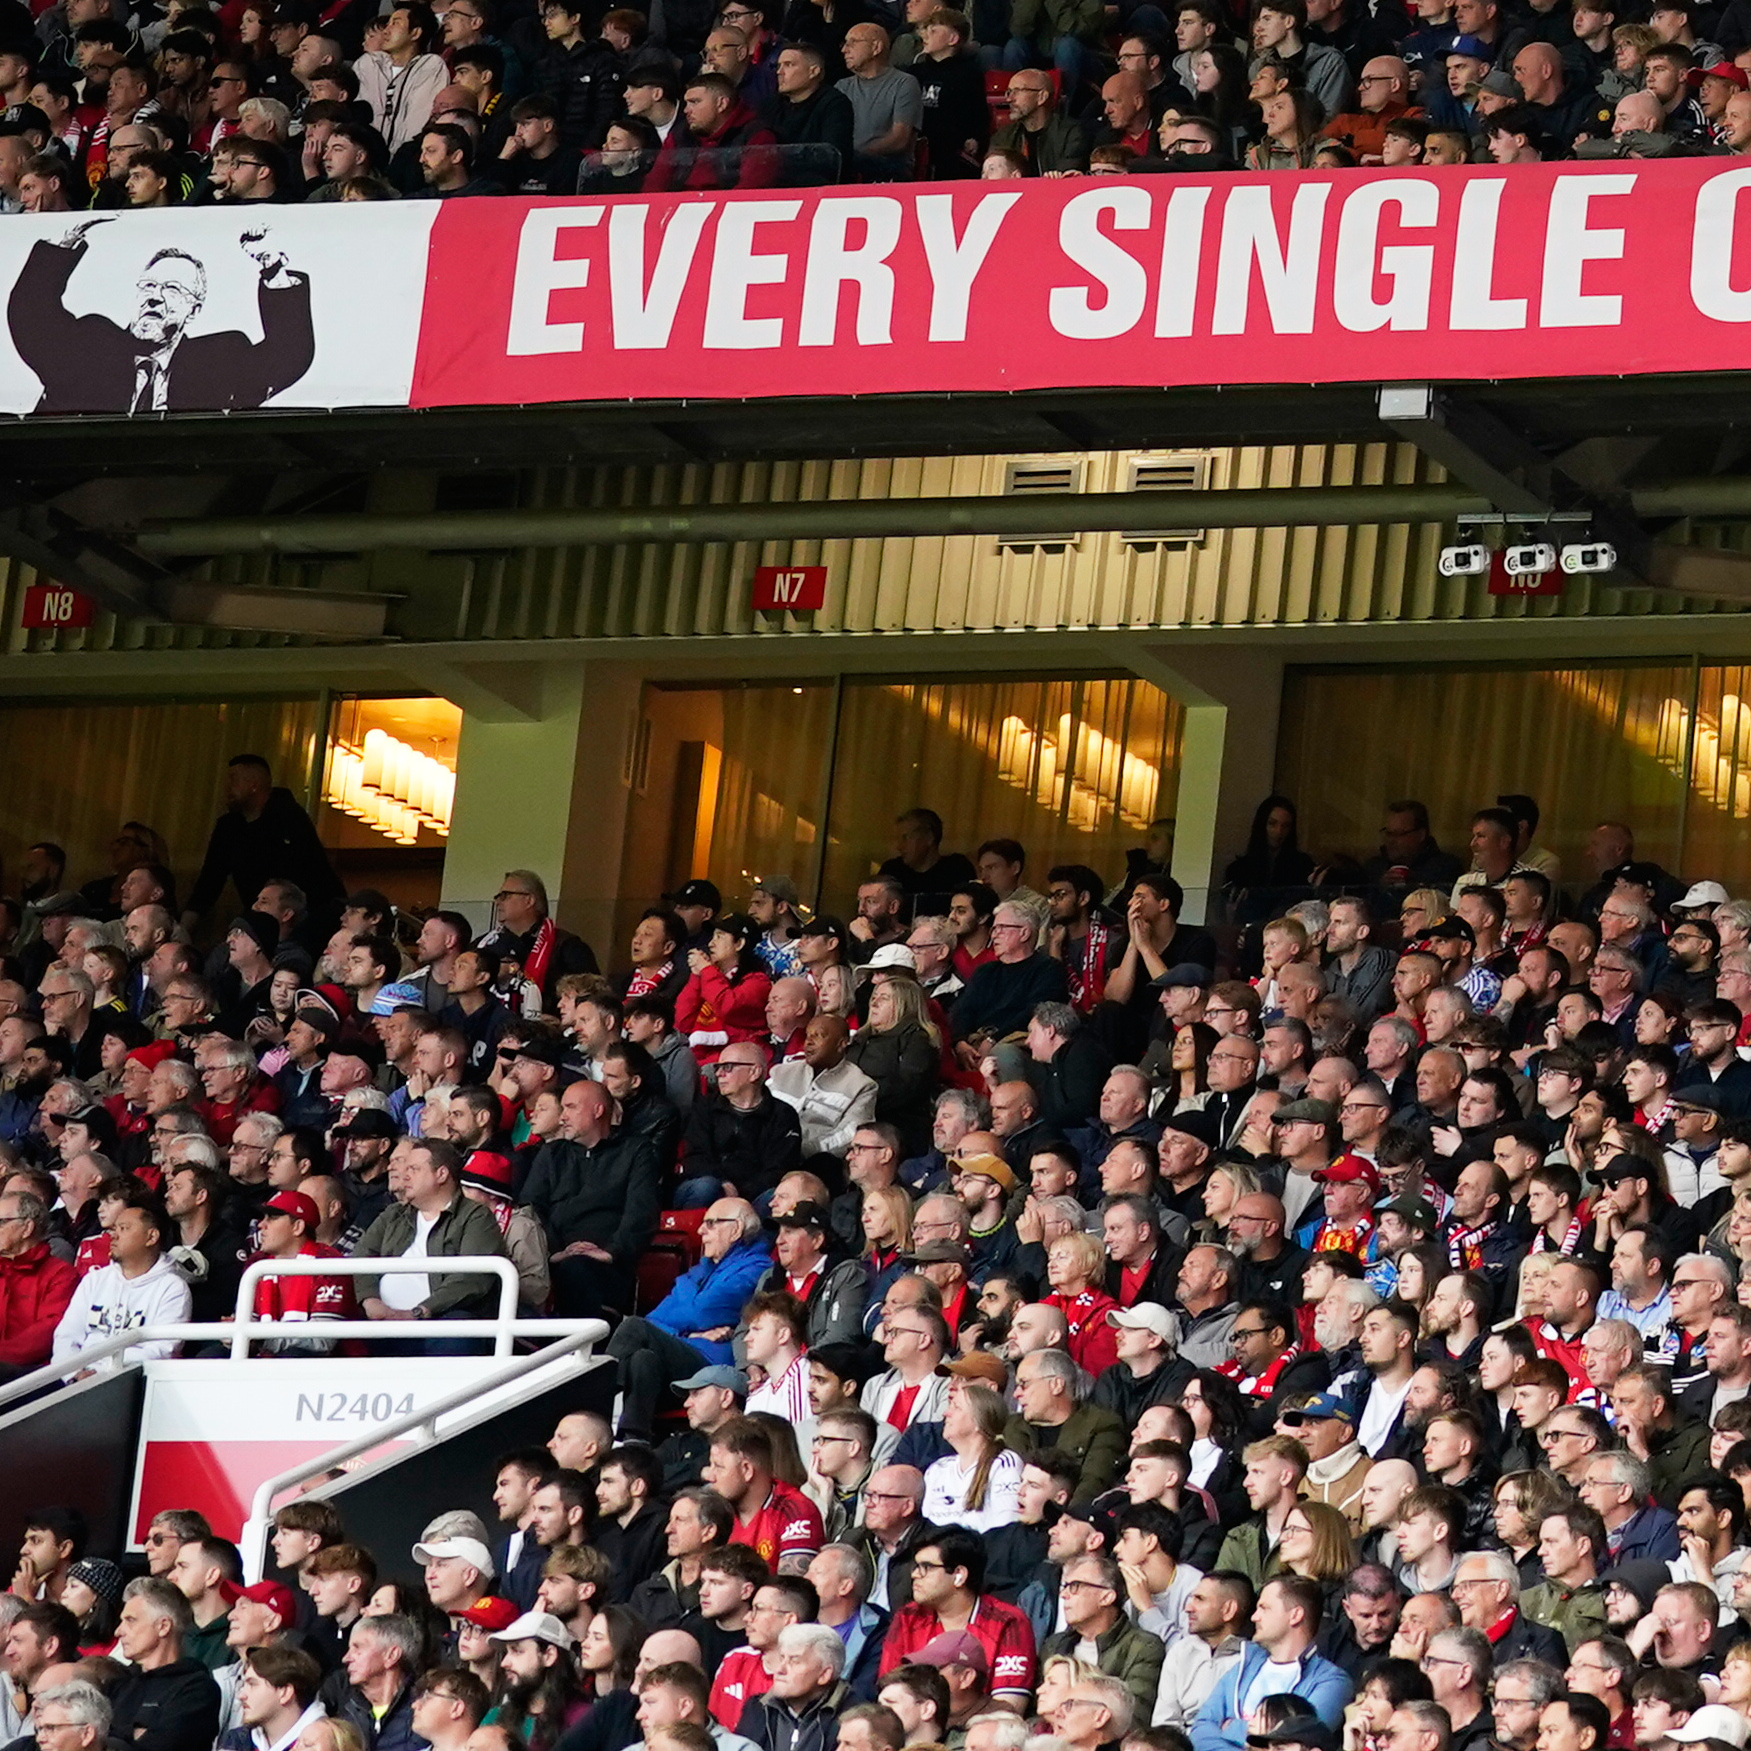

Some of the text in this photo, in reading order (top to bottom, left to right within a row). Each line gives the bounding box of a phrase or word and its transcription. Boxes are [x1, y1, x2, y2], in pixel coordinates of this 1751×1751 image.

[507, 193, 1024, 355] EVERY
[1049, 174, 1639, 339] SINGLE
[773, 573, 806, 603] N7
[43, 591, 75, 622] N8
[316, 1285, 344, 1300] DXC
[296, 1392, 416, 1422] N2404
[995, 1655, 1029, 1672] DXC
